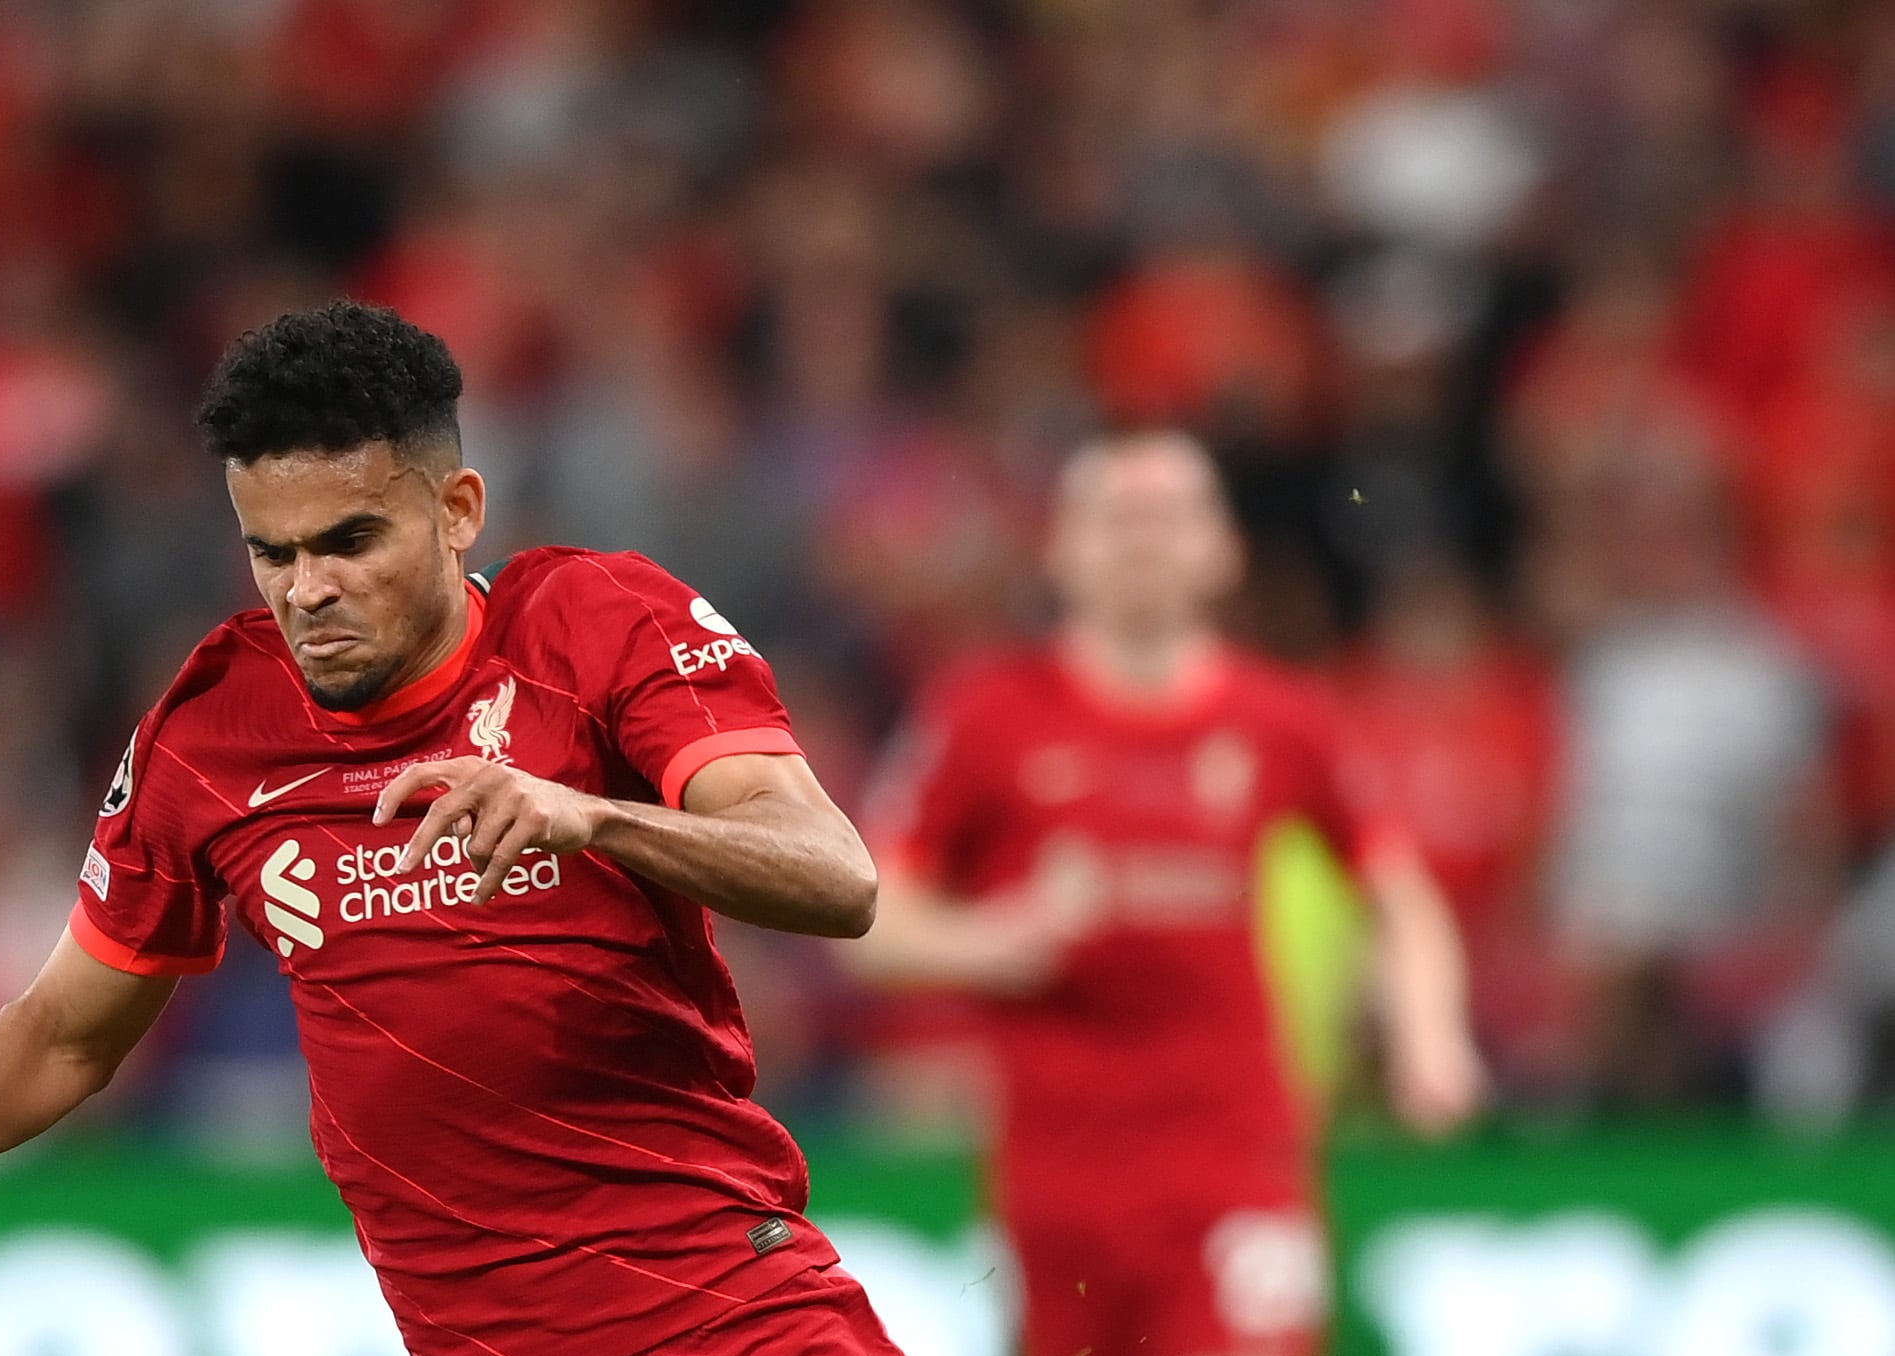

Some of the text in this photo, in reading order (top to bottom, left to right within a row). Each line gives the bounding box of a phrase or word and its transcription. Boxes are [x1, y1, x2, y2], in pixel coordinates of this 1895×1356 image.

[669, 637, 763, 676] Expe
[343, 769, 381, 783] FINAL
[339, 853, 561, 923] charteed
